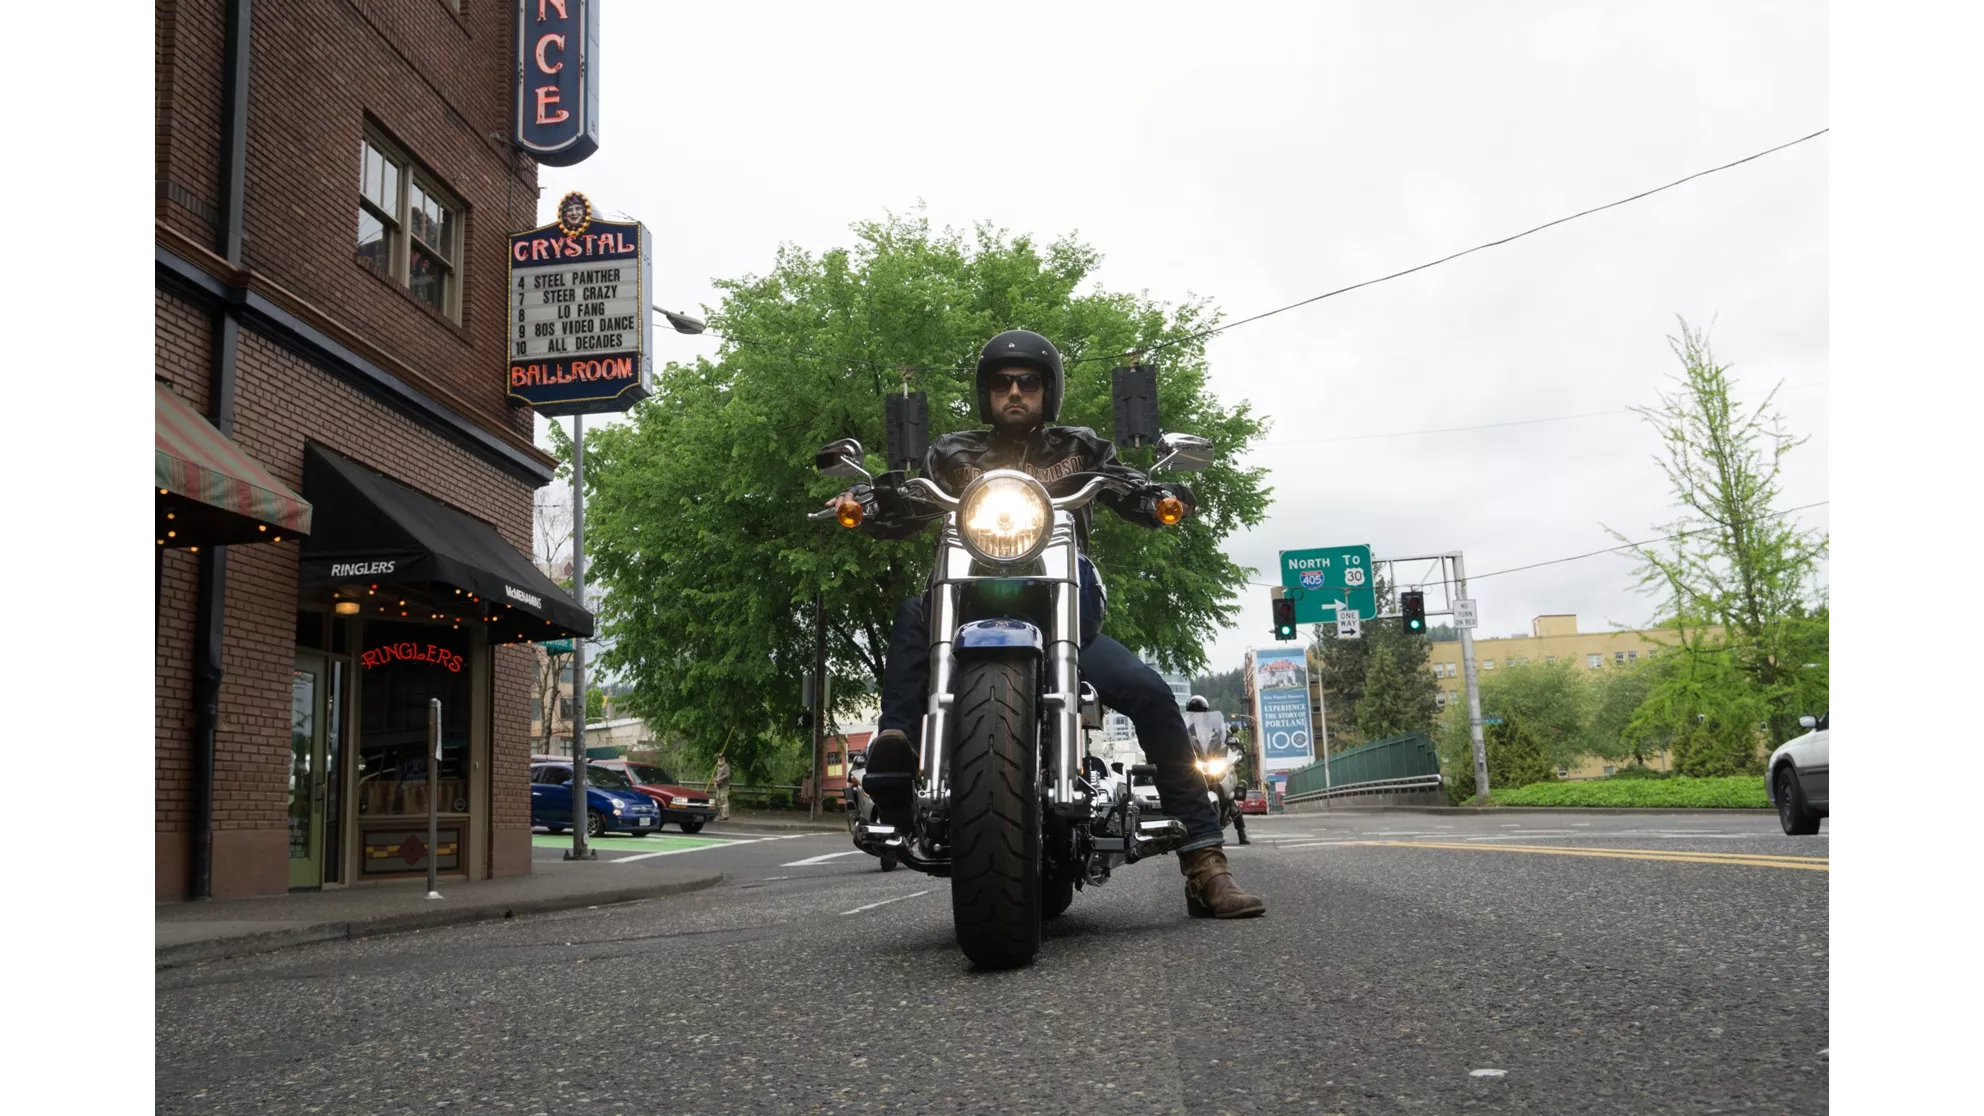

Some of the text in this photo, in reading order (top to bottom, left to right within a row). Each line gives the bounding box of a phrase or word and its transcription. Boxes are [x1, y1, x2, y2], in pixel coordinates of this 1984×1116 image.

[513, 232, 635, 261] CRYSTAL
[518, 268, 621, 290] 4 STEEL PANTHER
[518, 285, 618, 306] 7 STEER CRAZY
[518, 302, 605, 322] 8 LO FANG
[518, 316, 634, 338] 9 80S VIDEO DANCE
[516, 333, 623, 355] 10 ALL DECADES
[511, 357, 633, 387] BALLROOM
[331, 560, 396, 577] RINGLERS
[1288, 555, 1361, 570] NORTH TO
[1302, 570, 1362, 585] 405 30
[1340, 612, 1356, 620] ONE
[361, 642, 463, 673] RINGLERS
[1264, 703, 1307, 712] EXPERIENCE
[1278, 711, 1297, 719] STORY
[1267, 730, 1308, 749] 100
